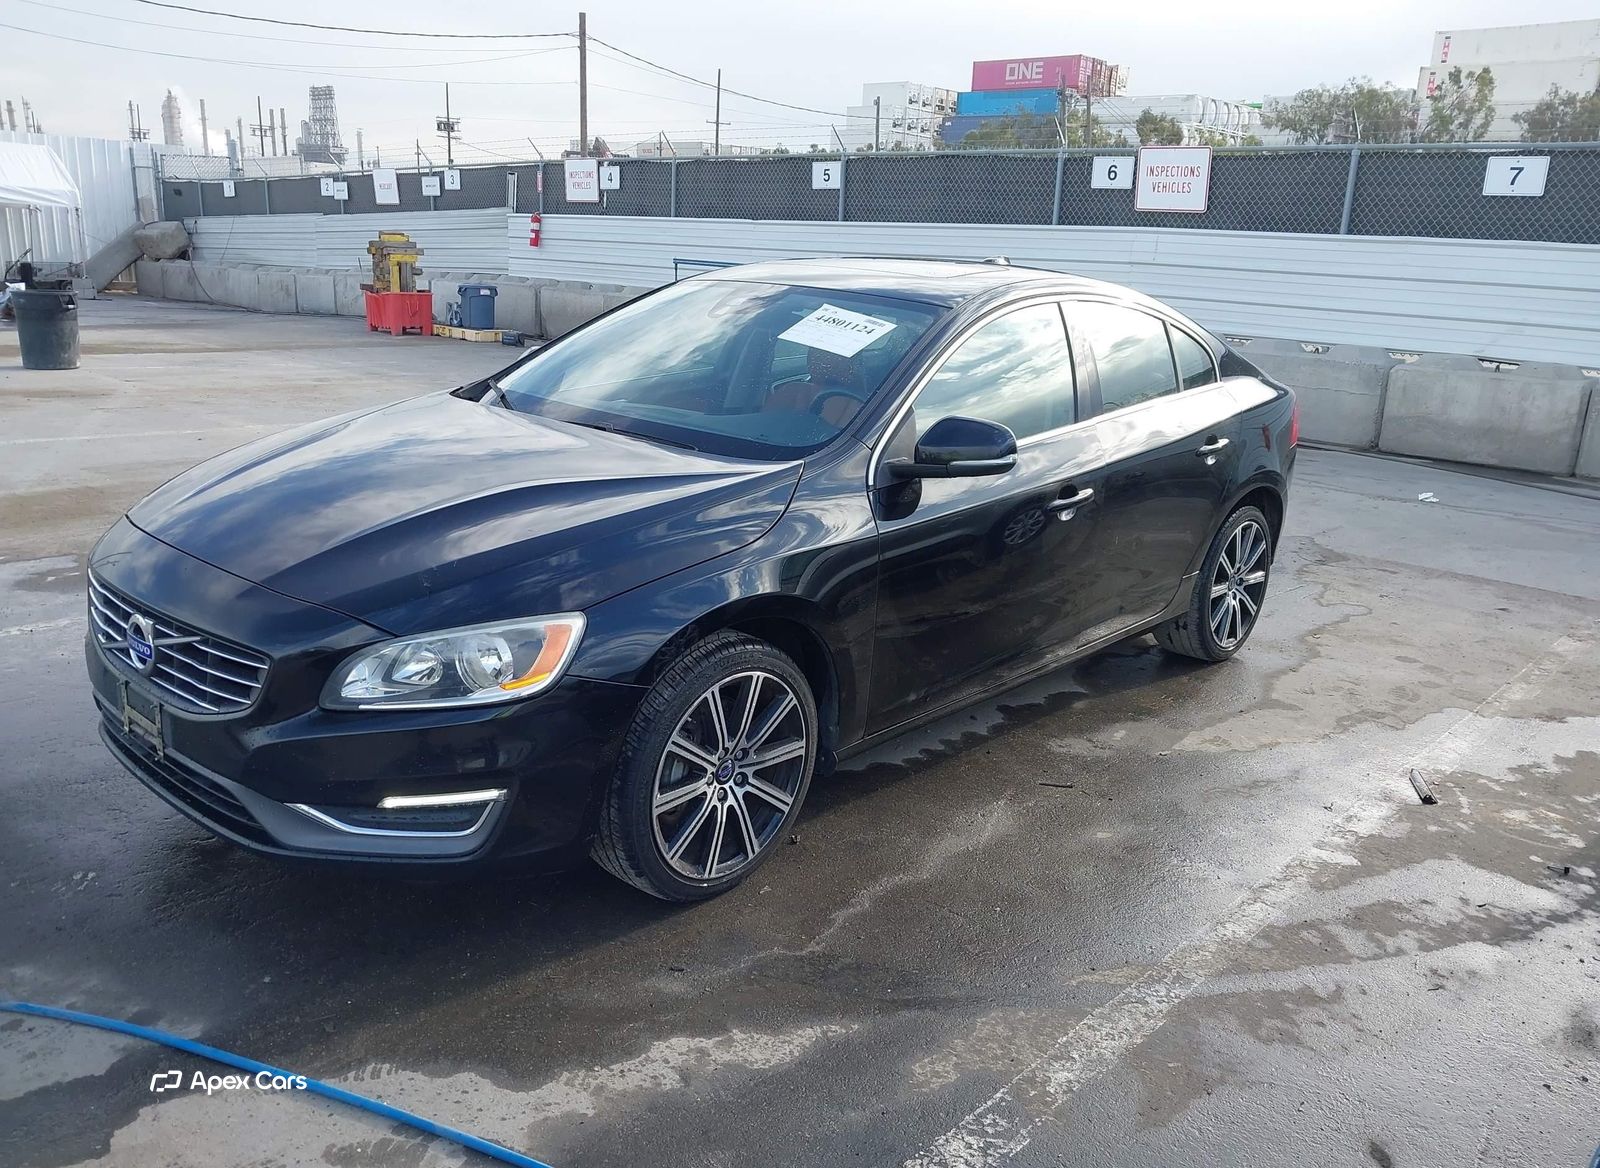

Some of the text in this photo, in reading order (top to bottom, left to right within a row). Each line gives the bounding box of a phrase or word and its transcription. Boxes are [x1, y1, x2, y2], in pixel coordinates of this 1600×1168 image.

[1005, 61, 1043, 80] ONE
[568, 171, 594, 179] INSPECTIONS
[607, 172, 613, 183] 4
[823, 168, 831, 182] 5
[1107, 164, 1118, 181] 6
[1146, 165, 1201, 178] INSPECTIONS
[1509, 166, 1525, 186] 7
[450, 174, 455, 185] 3
[572, 181, 591, 190] VEHICLES
[325, 182, 330, 192] 2
[1152, 181, 1192, 194] VEHICLES
[815, 314, 876, 335] 44801124
[128, 639, 151, 655] VOLVO
